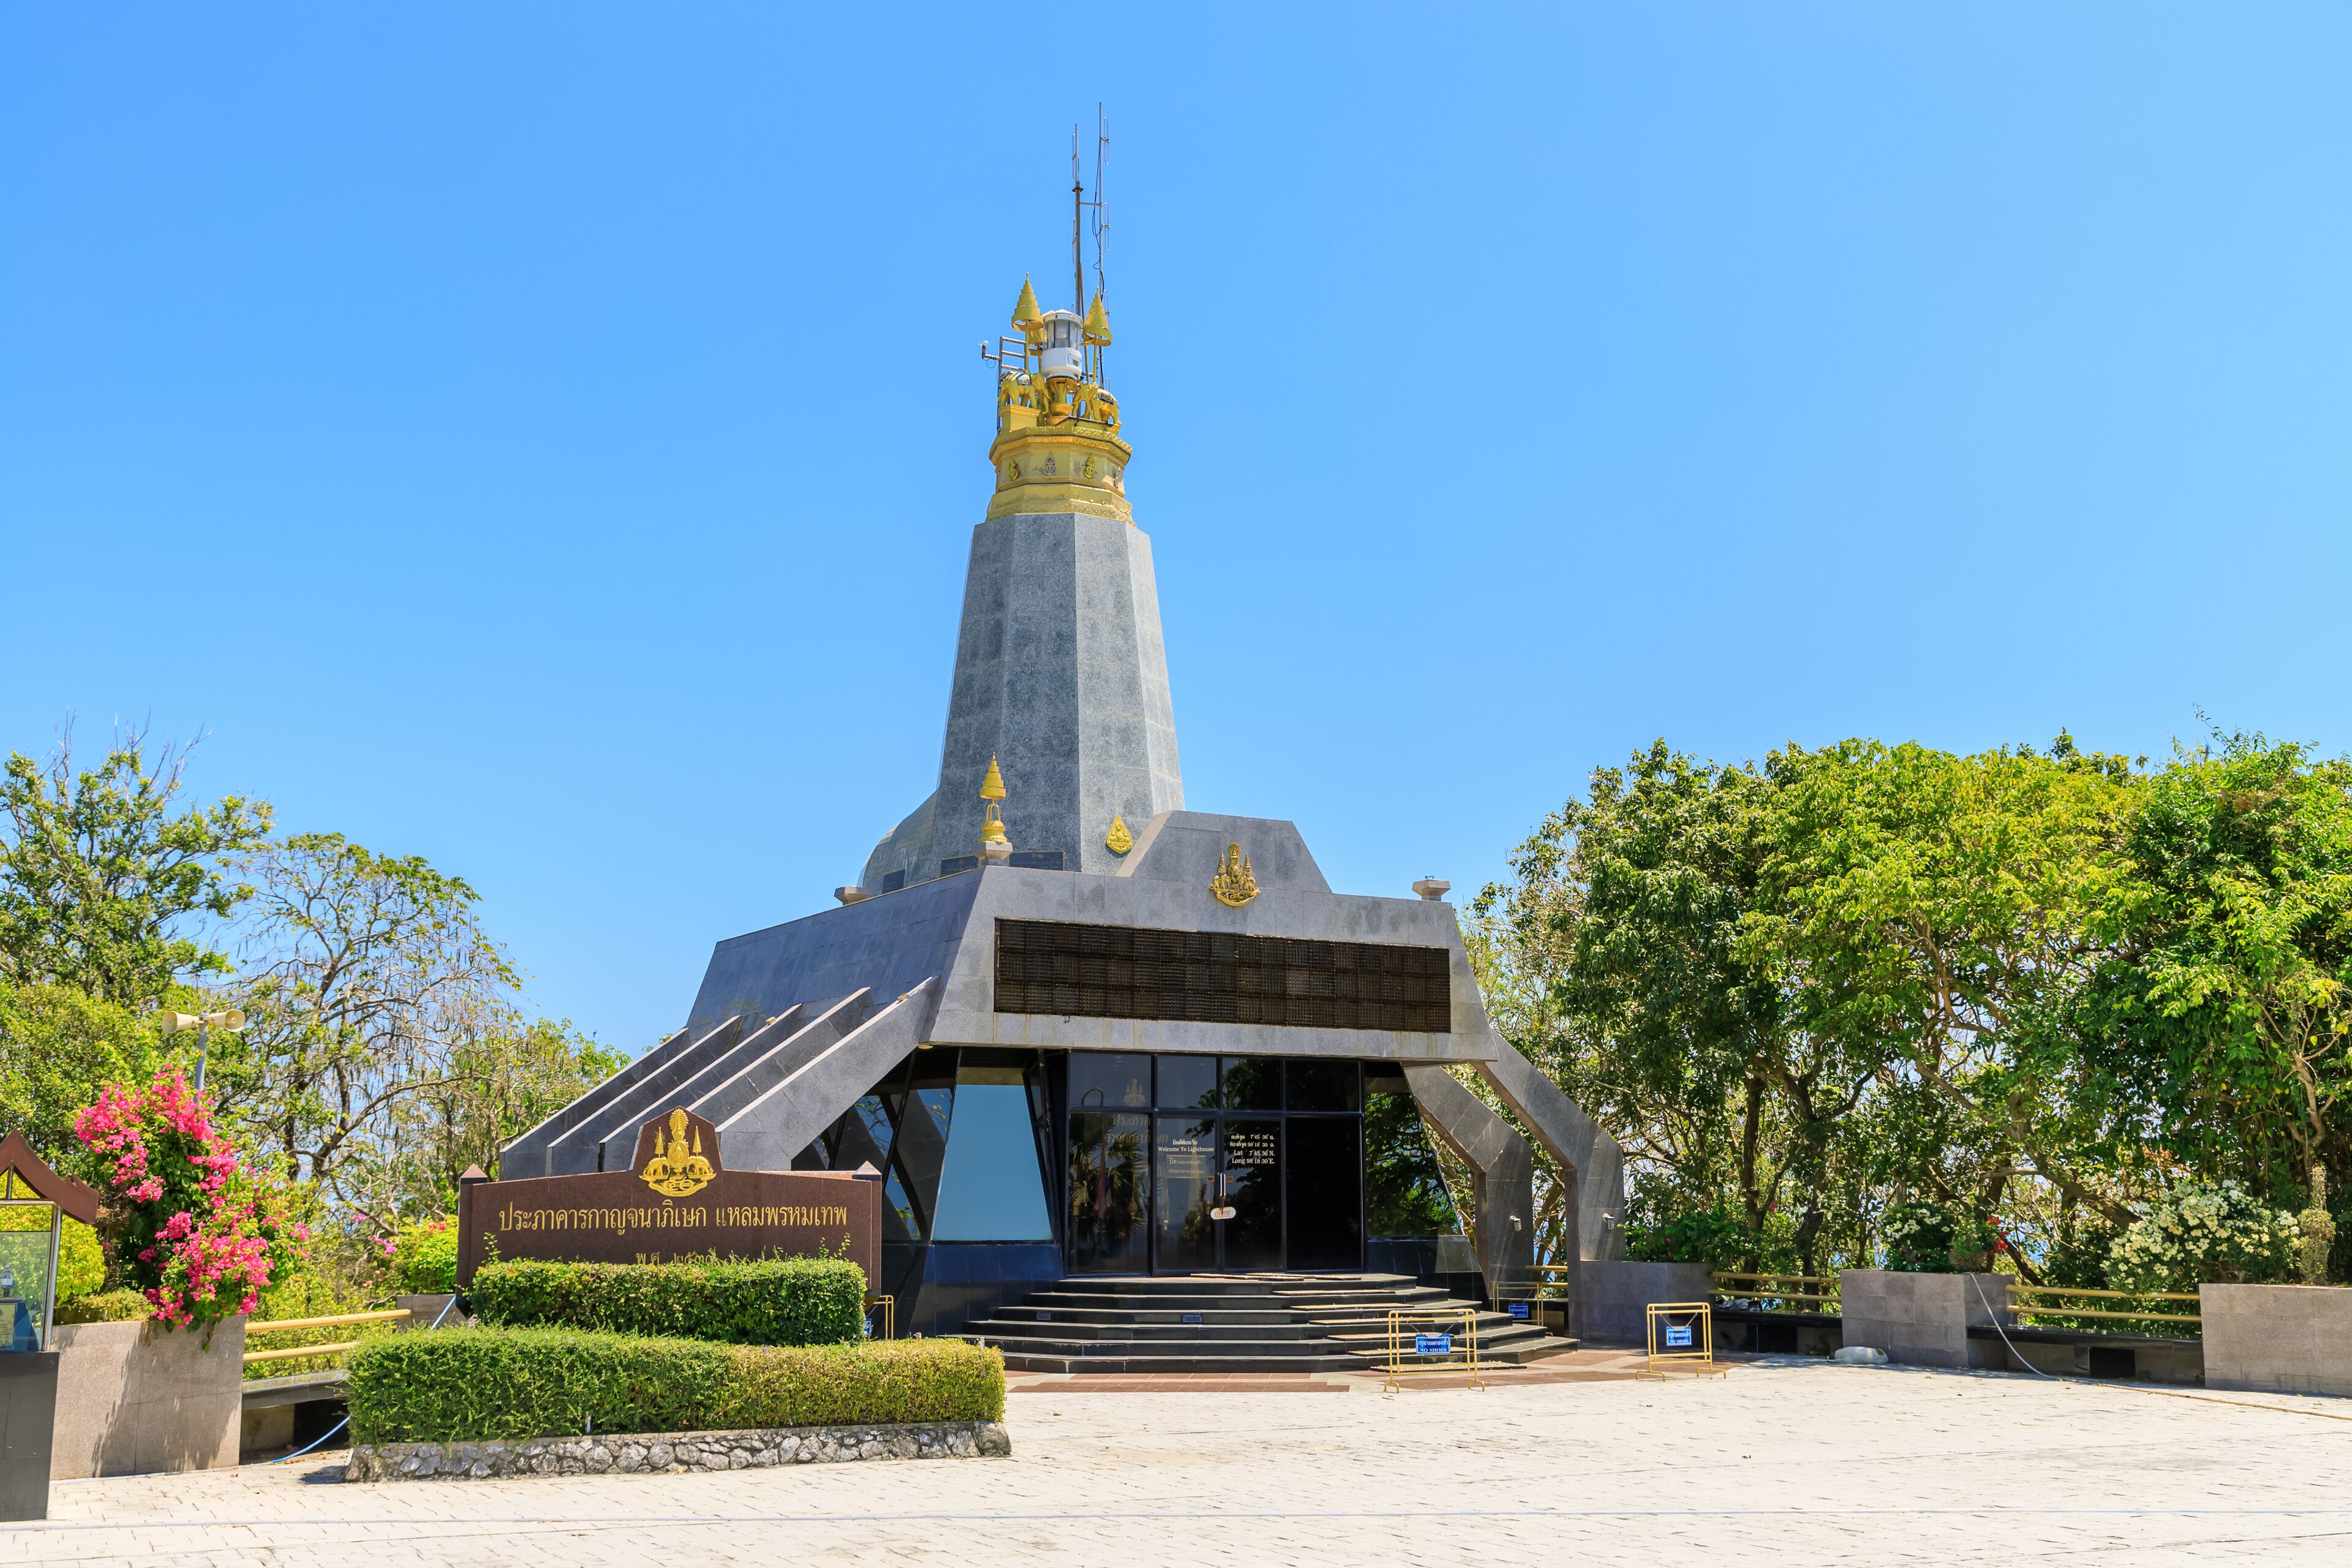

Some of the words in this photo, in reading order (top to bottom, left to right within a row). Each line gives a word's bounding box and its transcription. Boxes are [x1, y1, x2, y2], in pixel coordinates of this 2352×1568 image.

[499, 1199, 706, 1235] ประภาคารกาญจนาภิเษก
[716, 1206, 847, 1226] แหลมพรหมเทพ
